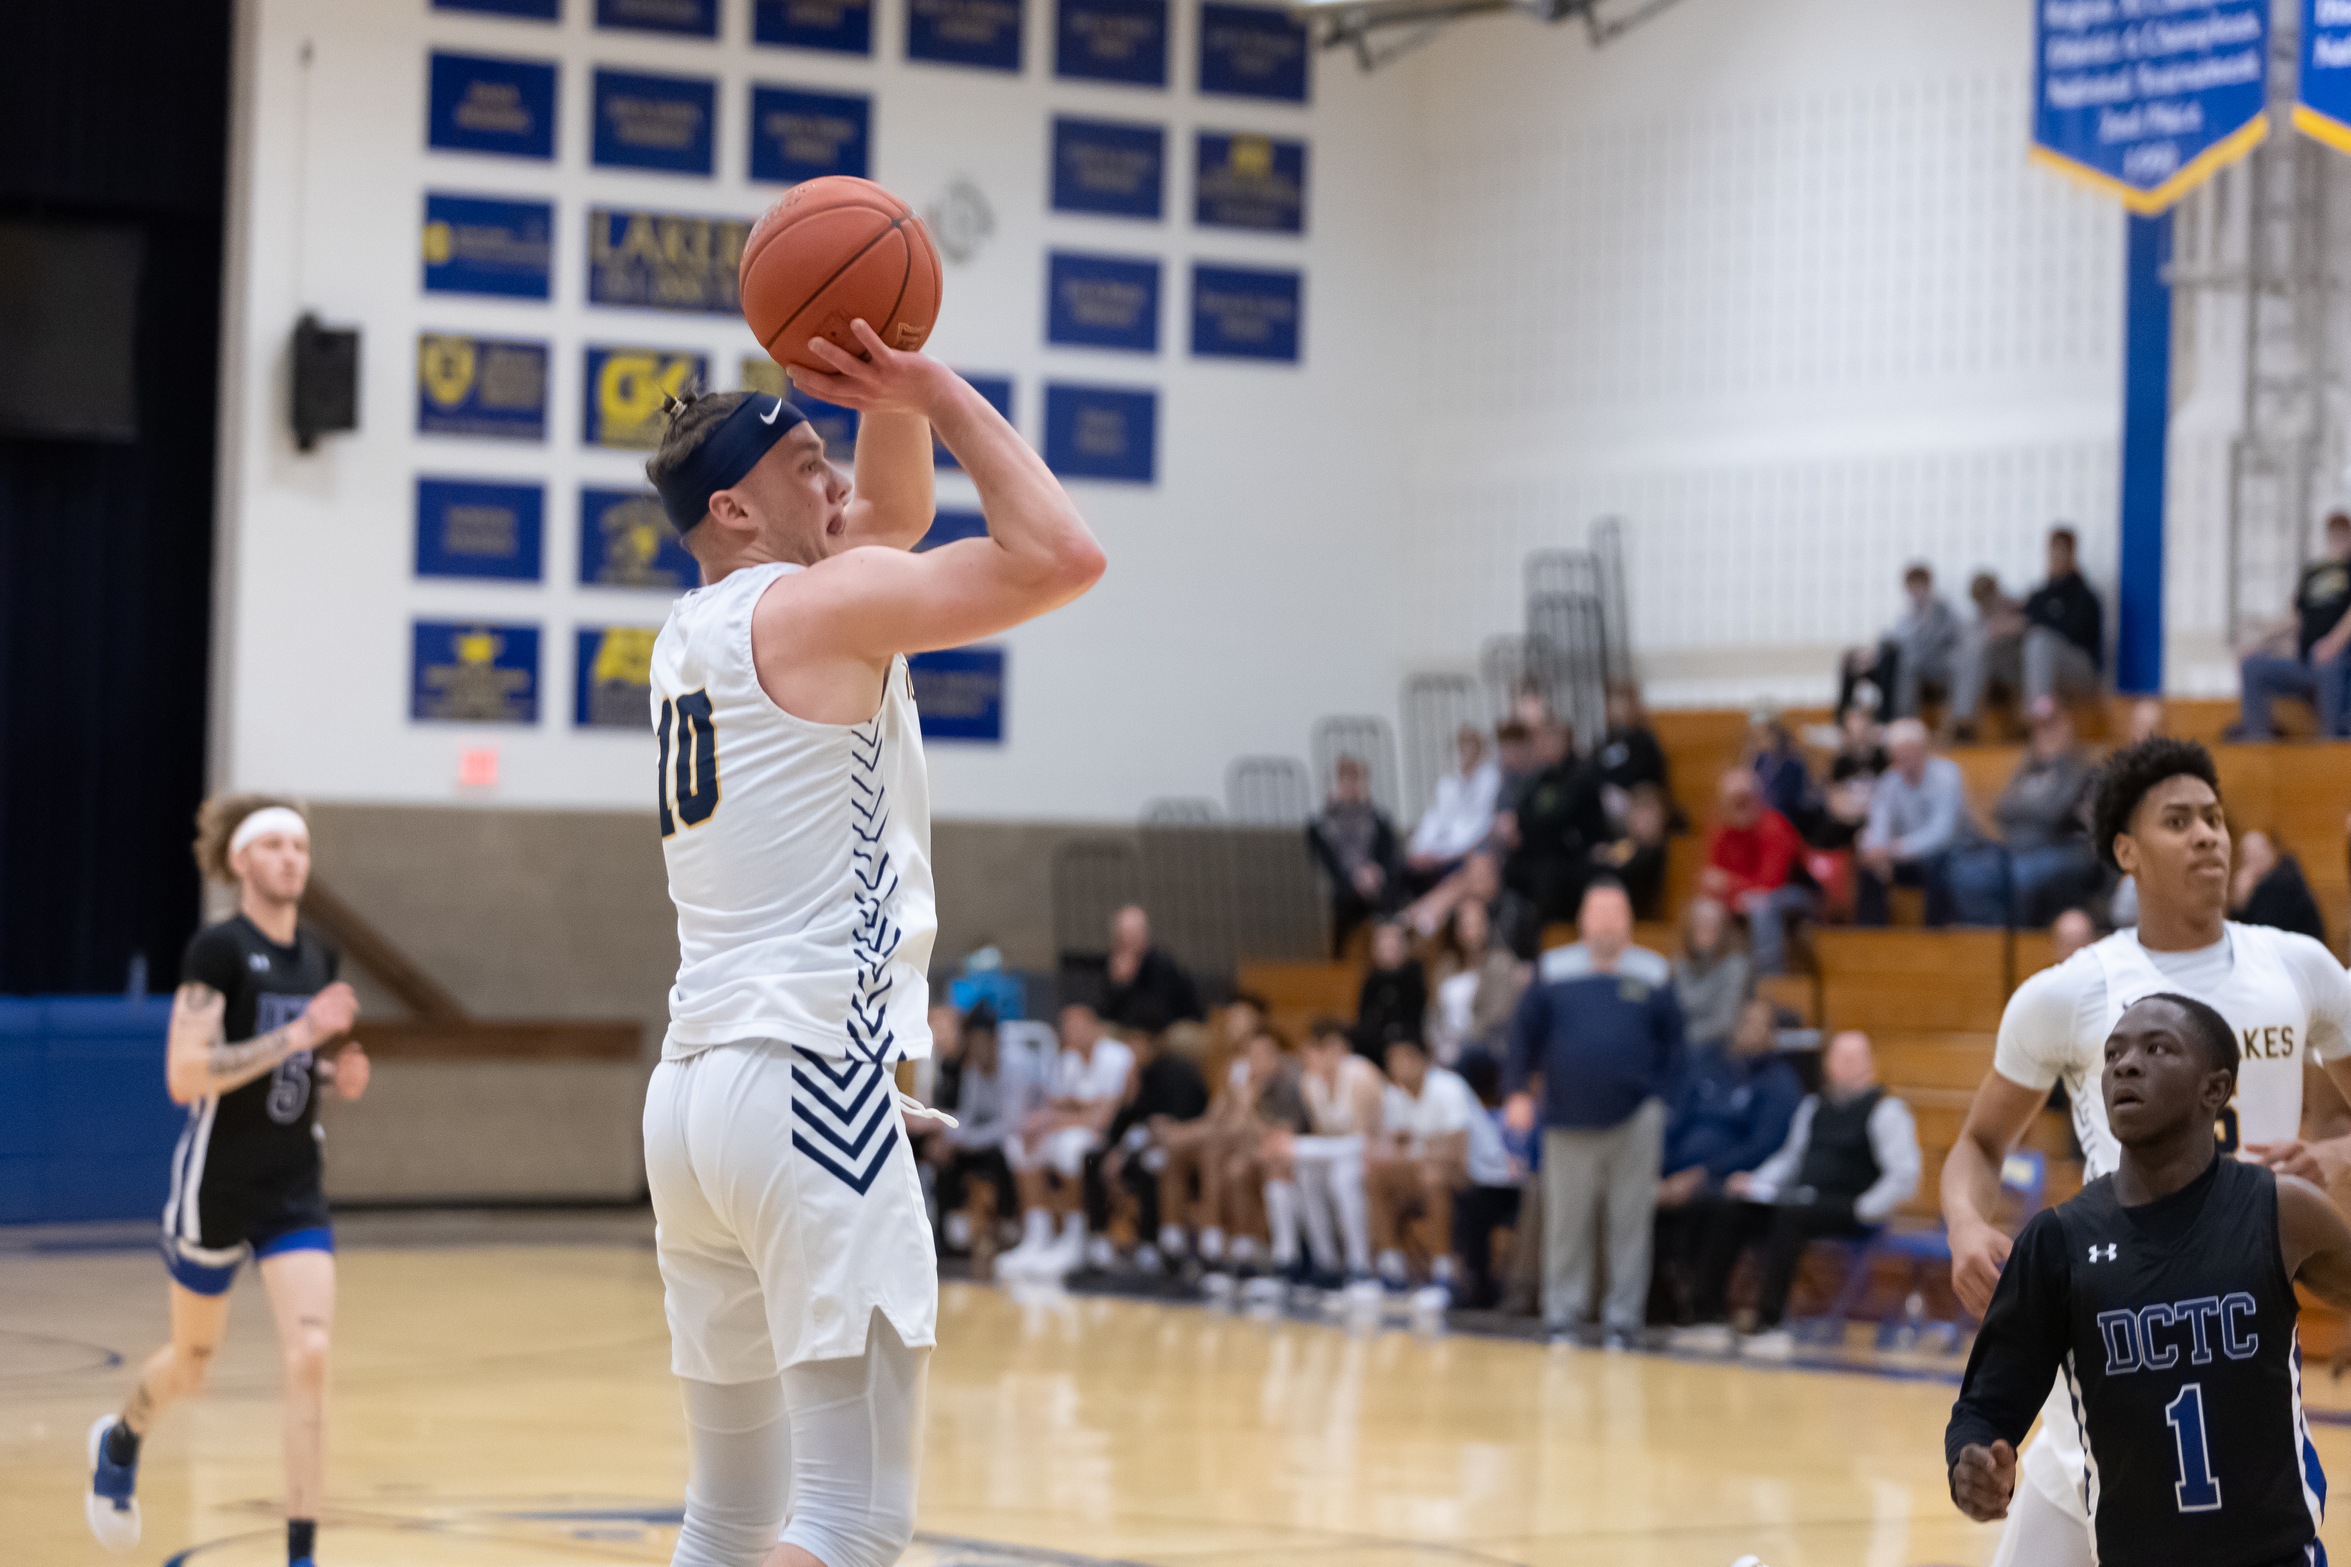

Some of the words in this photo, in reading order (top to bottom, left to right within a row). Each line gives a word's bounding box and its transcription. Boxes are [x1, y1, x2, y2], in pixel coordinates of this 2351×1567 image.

[657, 686, 722, 841] 10
[2239, 1025, 2294, 1060] KES
[2098, 1291, 2259, 1376] DCTC
[2165, 1383, 2222, 1513] 1
